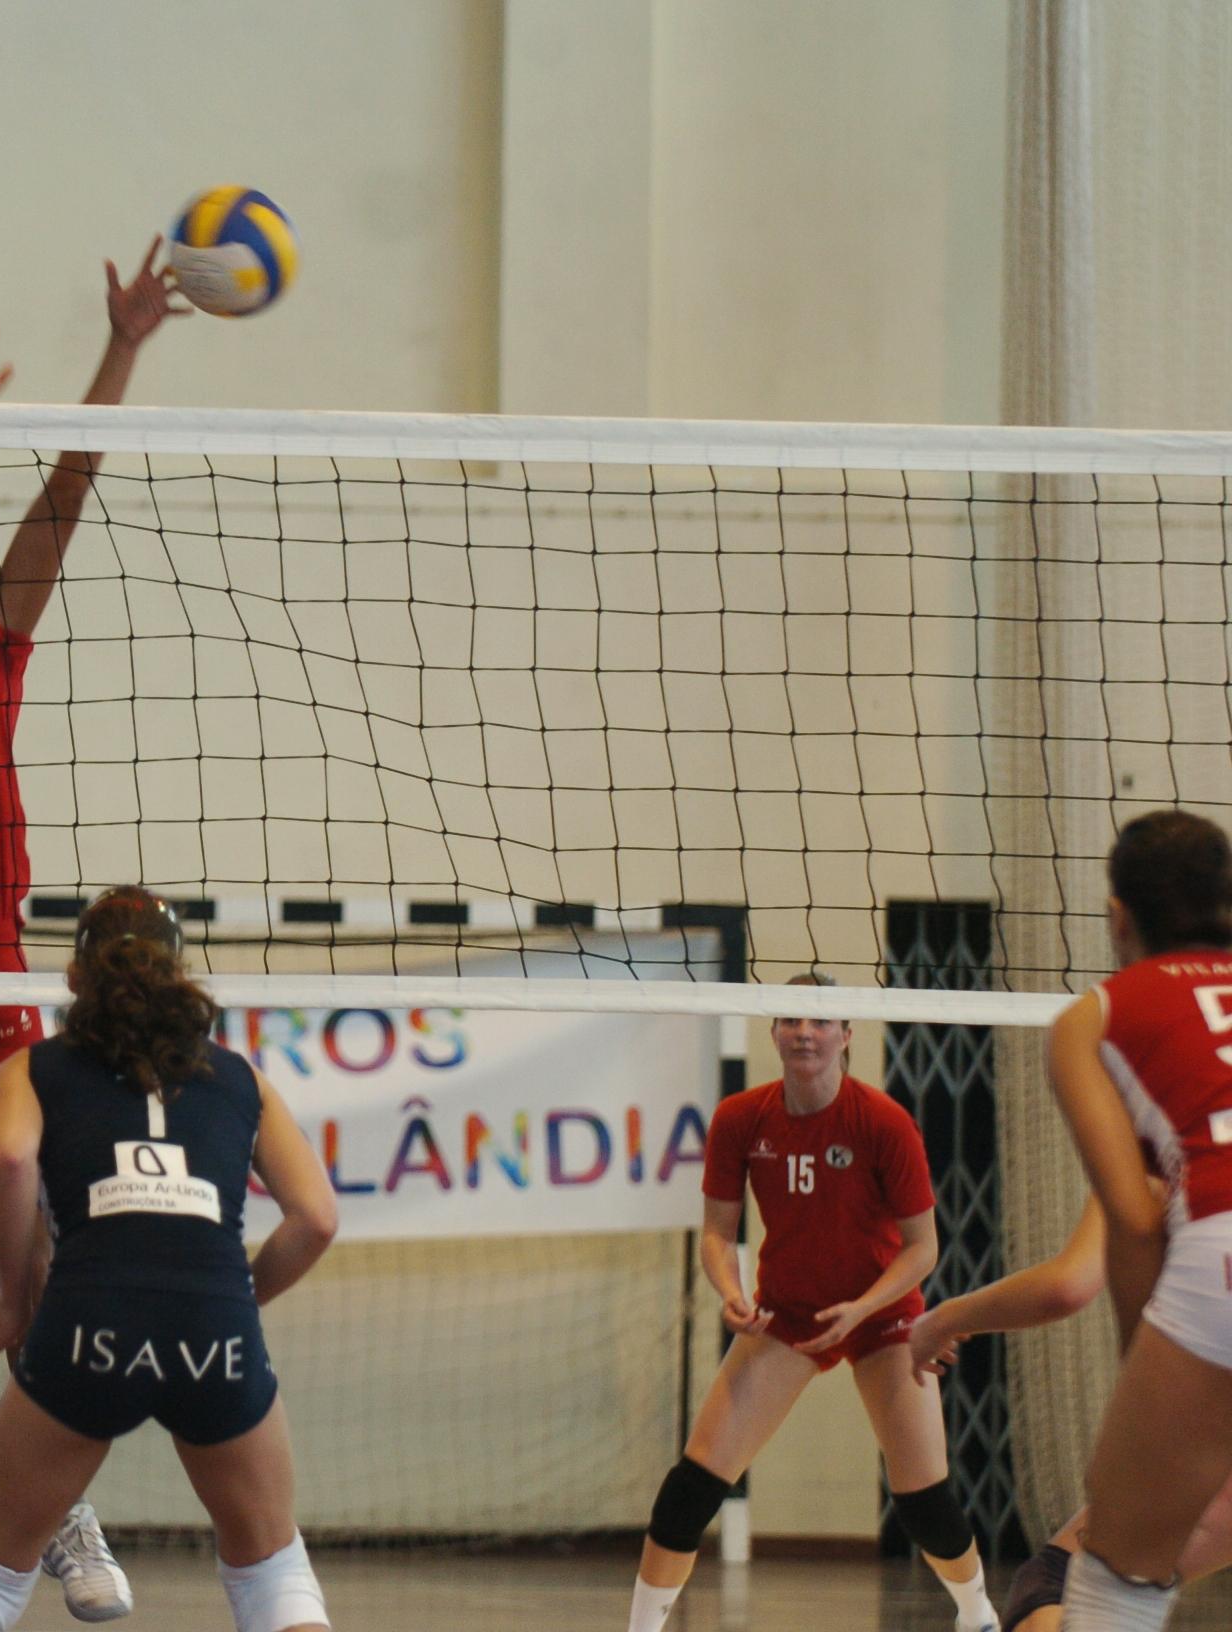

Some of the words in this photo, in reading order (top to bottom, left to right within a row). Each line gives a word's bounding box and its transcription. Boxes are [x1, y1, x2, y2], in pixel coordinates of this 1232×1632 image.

[248, 1097, 708, 1196] LÂNDIA
[98, 1182, 148, 1198] Europa
[154, 1182, 213, 1202] Ar-Lindo
[787, 1154, 815, 1195] 15
[71, 1323, 243, 1381] ISAVE
